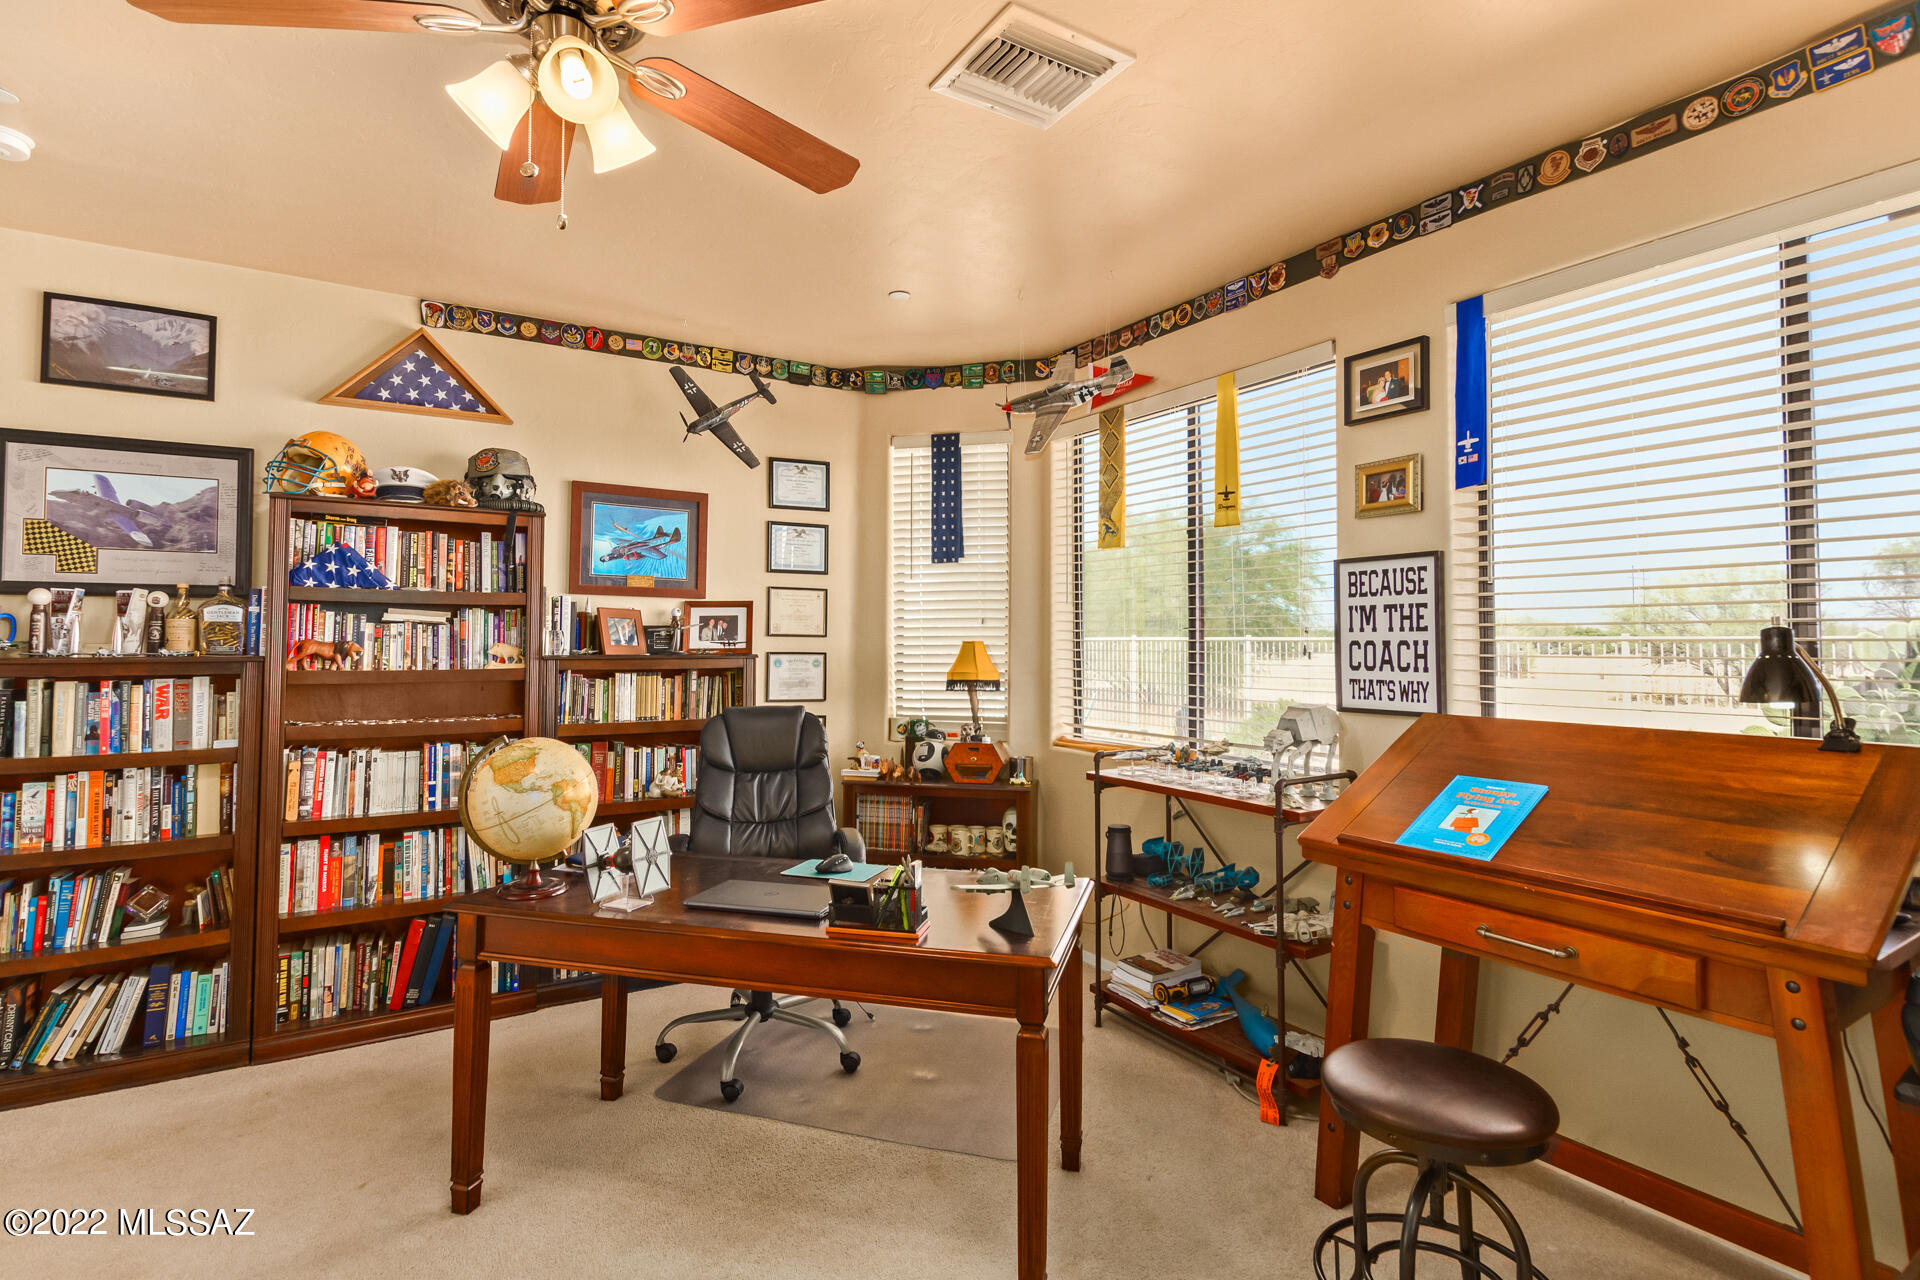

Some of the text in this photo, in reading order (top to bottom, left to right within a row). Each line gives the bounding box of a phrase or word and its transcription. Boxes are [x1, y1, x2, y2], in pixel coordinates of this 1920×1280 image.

[1347, 565, 1428, 599] BECAUSE
[1348, 602, 1429, 633] I'M THE
[1348, 640, 1429, 673] COACH
[154, 684, 170, 721] WAR
[1349, 679, 1429, 704] THAT'S WHY
[195, 705, 204, 718] KIND
[195, 725, 204, 737] WAR
[136, 792, 144, 812] WRONG
[1456, 792, 1520, 806] Flying Ace
[1470, 786, 1517, 798] Snoopy:
[279, 994, 287, 1006] WAR
[2, 1003, 17, 1054] JOHNNY CASH
